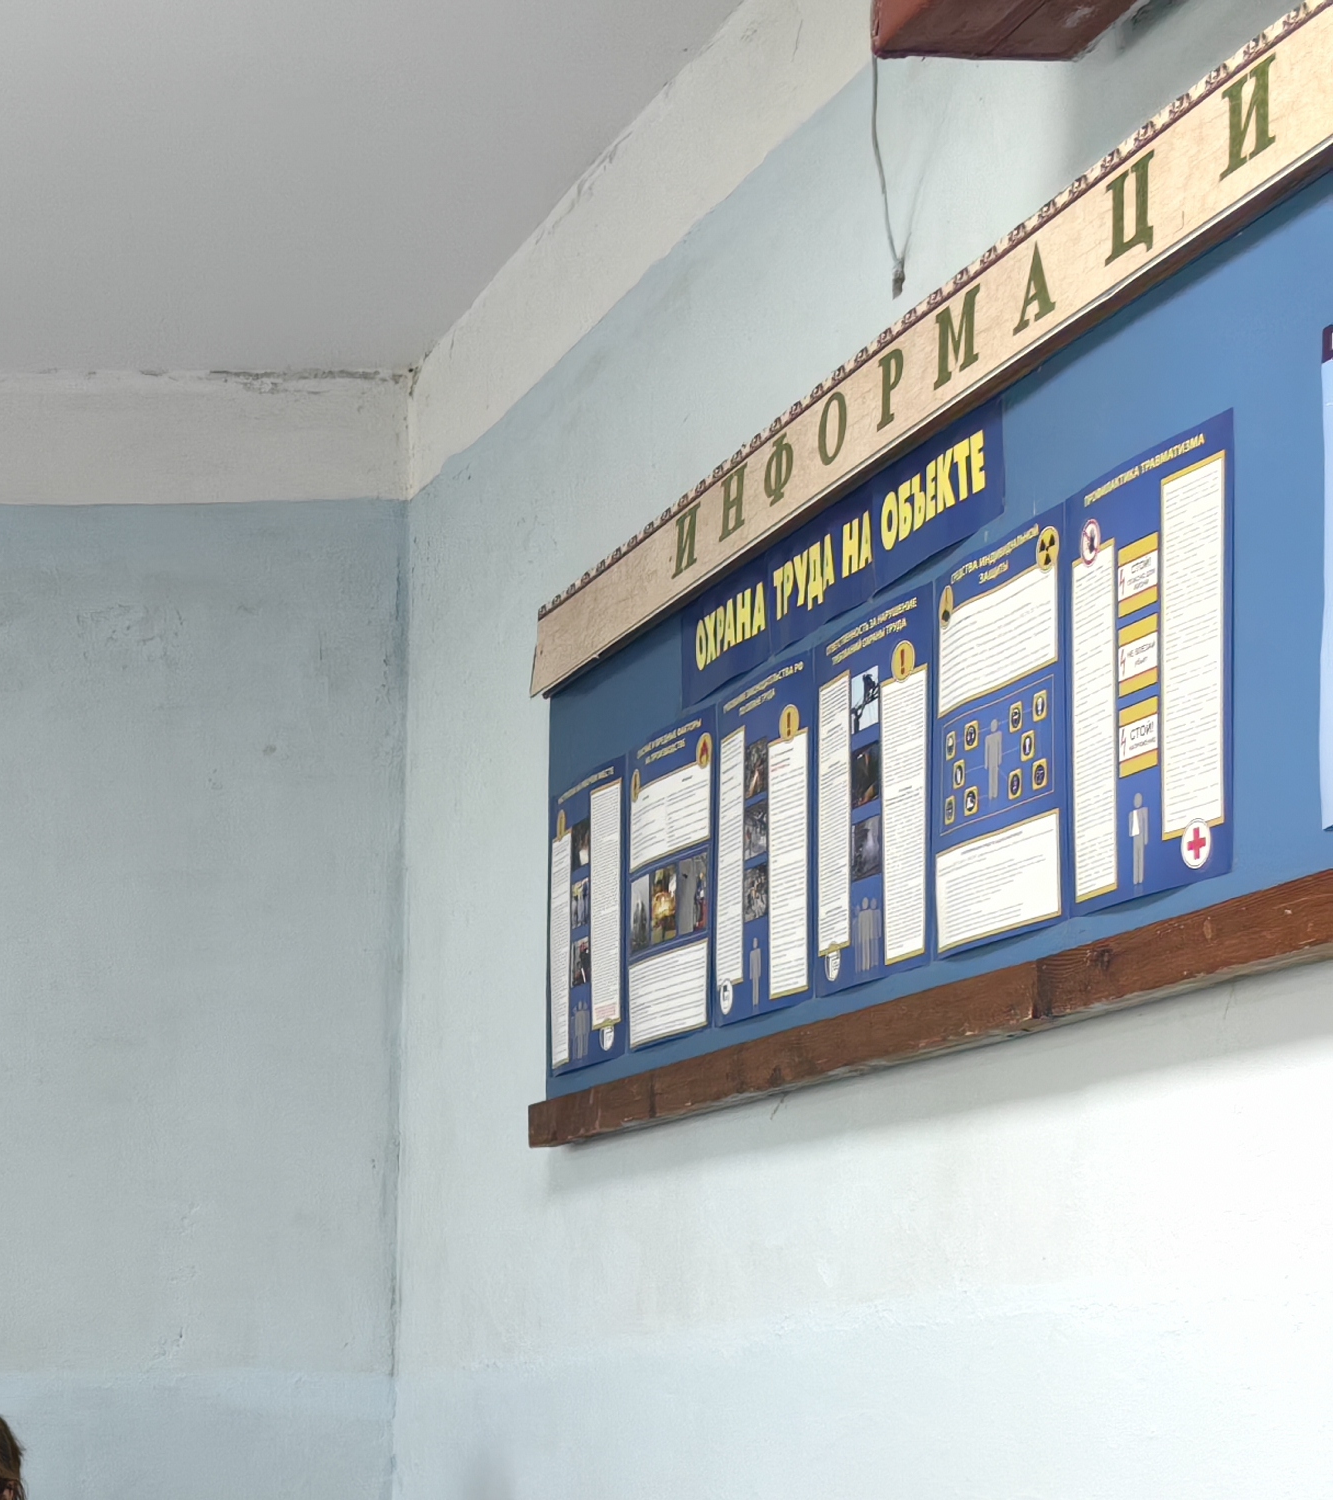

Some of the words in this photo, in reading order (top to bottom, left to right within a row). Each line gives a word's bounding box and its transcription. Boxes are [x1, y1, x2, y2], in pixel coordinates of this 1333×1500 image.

[1140, 433, 1205, 473] ТРАВМАТИЗМА
[695, 582, 766, 670] ОХРАНА
[773, 533, 835, 621] ТРУДА
[842, 510, 873, 578] НА
[881, 429, 986, 550] ОБЪЕКТЕ
[1130, 719, 1154, 741] СТОЙ!
